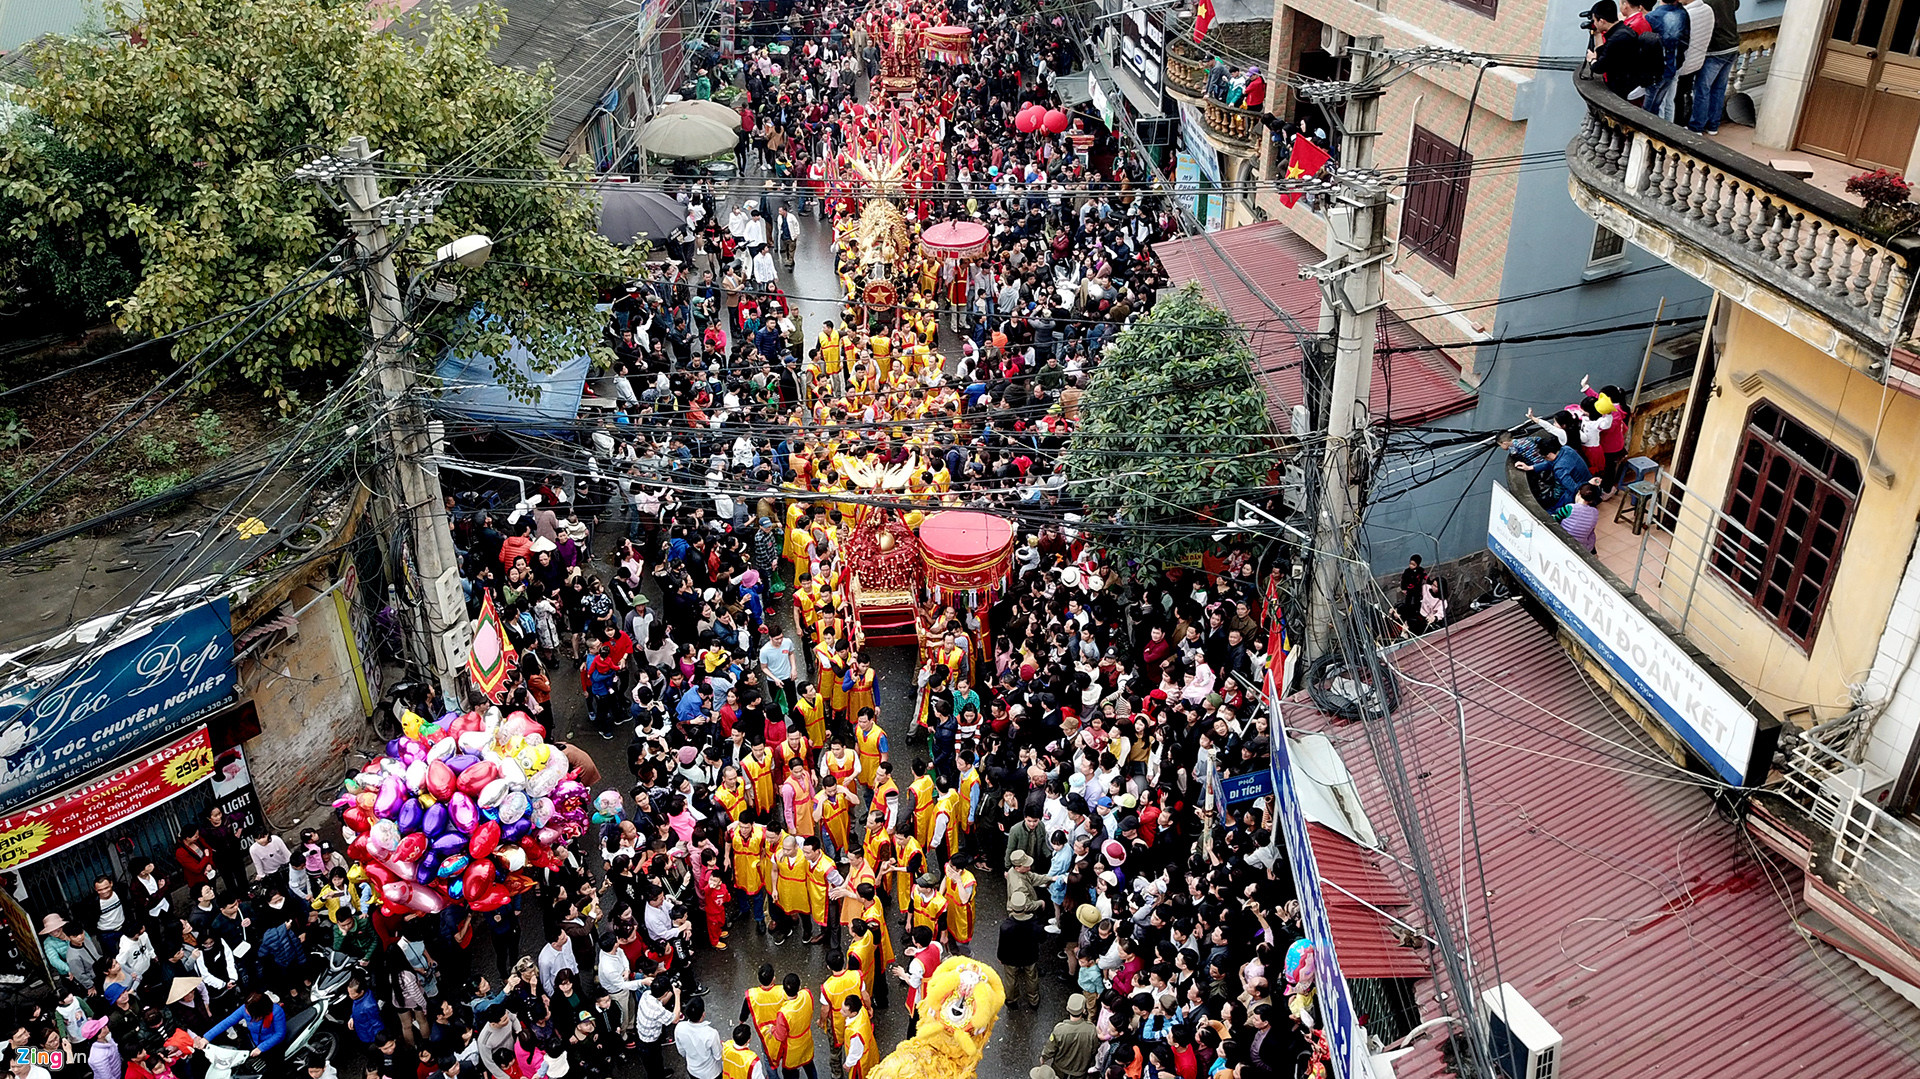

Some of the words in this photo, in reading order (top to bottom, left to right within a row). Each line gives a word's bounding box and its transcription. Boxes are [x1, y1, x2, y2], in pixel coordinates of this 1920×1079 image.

[1565, 558, 1615, 610] CÔNG
[1622, 609, 1645, 635] TY
[1650, 637, 1704, 691] TNHH
[1537, 551, 1578, 604] VẬN
[1583, 600, 1614, 638] TẢI
[1615, 629, 1681, 702] ĐOÀN
[1685, 694, 1728, 744] KẾT
[24, 670, 110, 744] Tóc
[127, 635, 224, 697] Đẹp
[52, 739, 87, 761] TÓC
[91, 704, 159, 743] CHUYÊN
[163, 673, 226, 711] NGHIỆP
[94, 739, 116, 753] TẠO
[118, 727, 140, 742] HỌC
[142, 716, 166, 731] VIÊN
[82, 756, 104, 772] Ninh
[175, 757, 200, 779] 299
[200, 753, 210, 768] K
[83, 781, 128, 806] COMBO
[222, 791, 251, 815] LIGHT
[1229, 789, 1240, 799] DI
[1241, 784, 1262, 796] TÍCH
